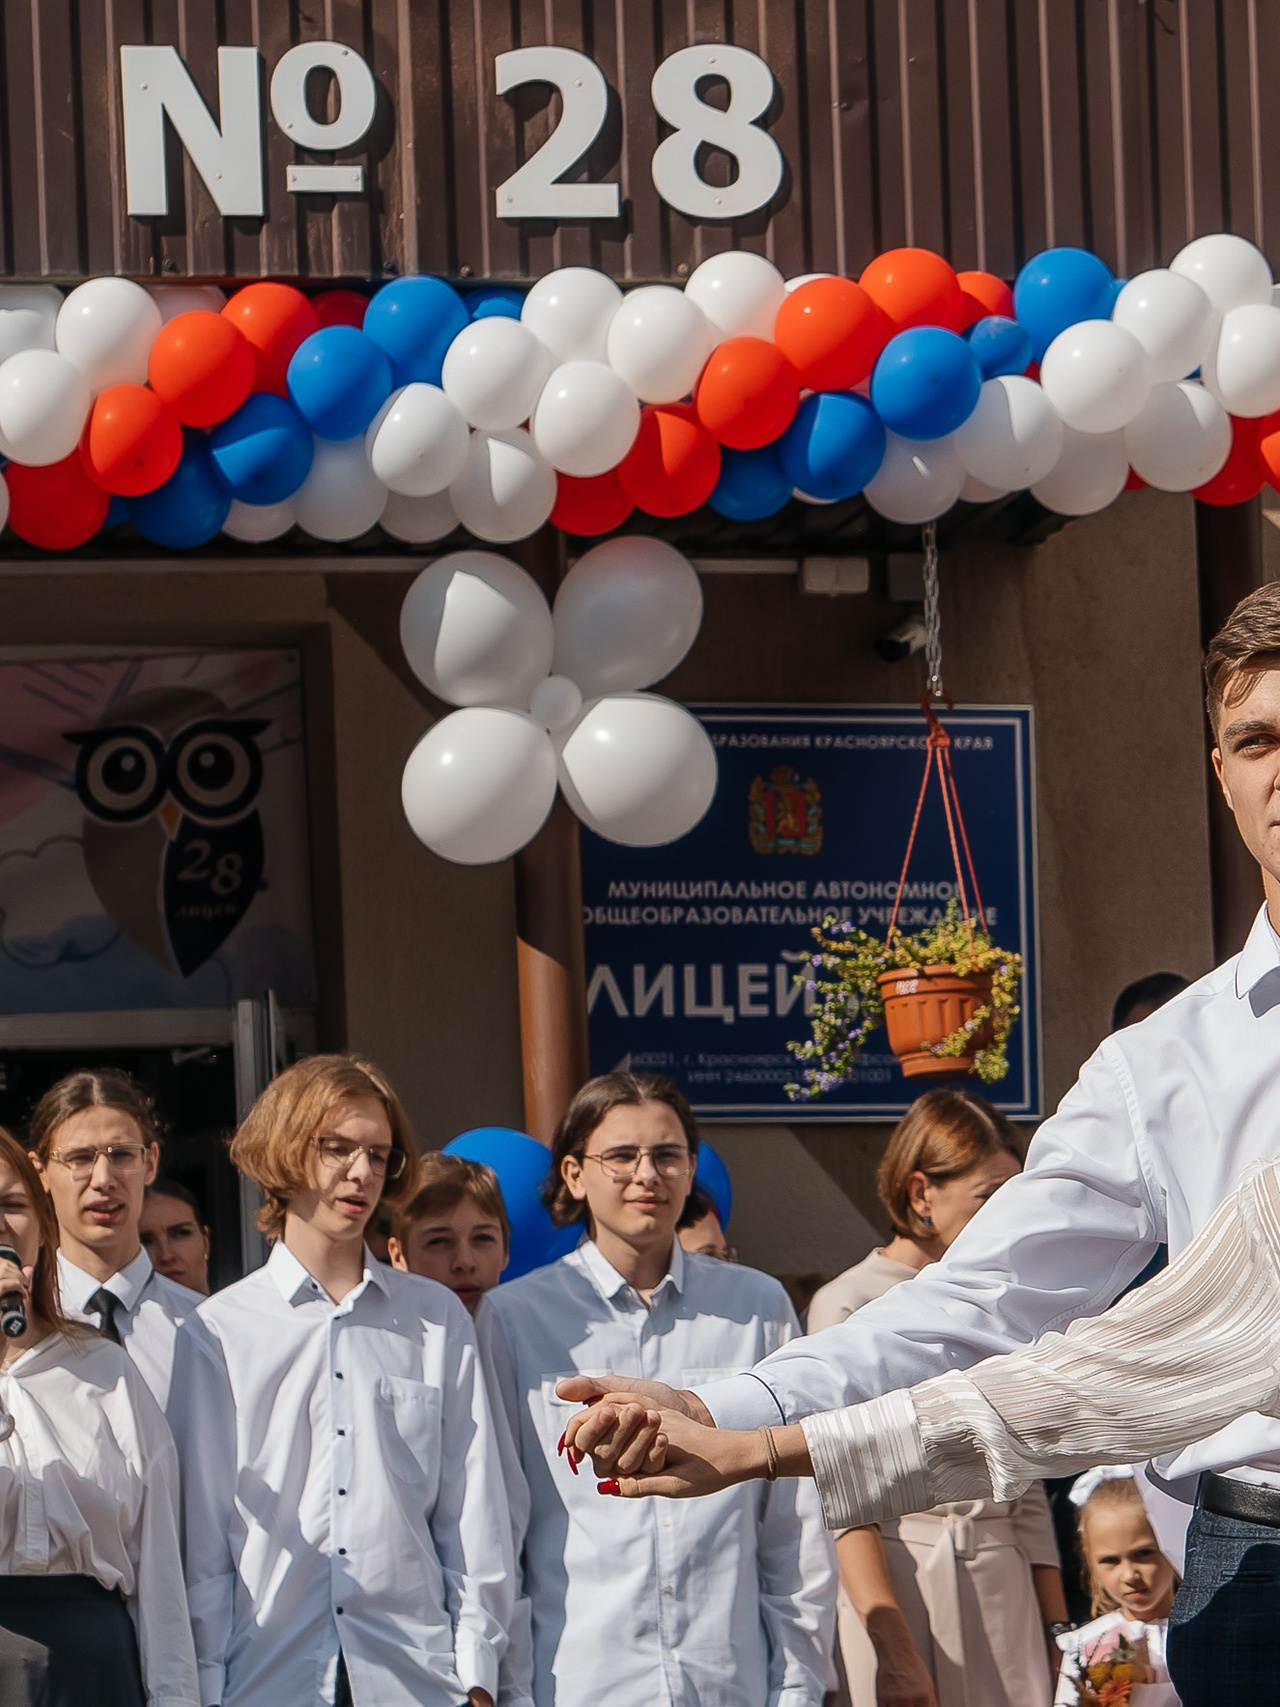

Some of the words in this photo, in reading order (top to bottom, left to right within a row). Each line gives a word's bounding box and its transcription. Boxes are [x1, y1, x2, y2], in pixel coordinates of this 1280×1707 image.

[119, 40, 377, 217] №
[494, 43, 786, 219] 28
[711, 733, 810, 748] БРАЗОВАНИЯ
[813, 734, 928, 750] КРАСНОЯРСКО
[953, 735, 993, 750] КРАЯ
[177, 837, 243, 895] 28
[607, 880, 807, 900] МУНИЦИПАЛЬНОЕ
[583, 906, 852, 926] ОБЩЕОБРАЗОВАТЕЛЬНОЕ
[857, 906, 998, 926] УЧРЕЖДЕ
[587, 950, 816, 1024] ЛИЦЕЙ
